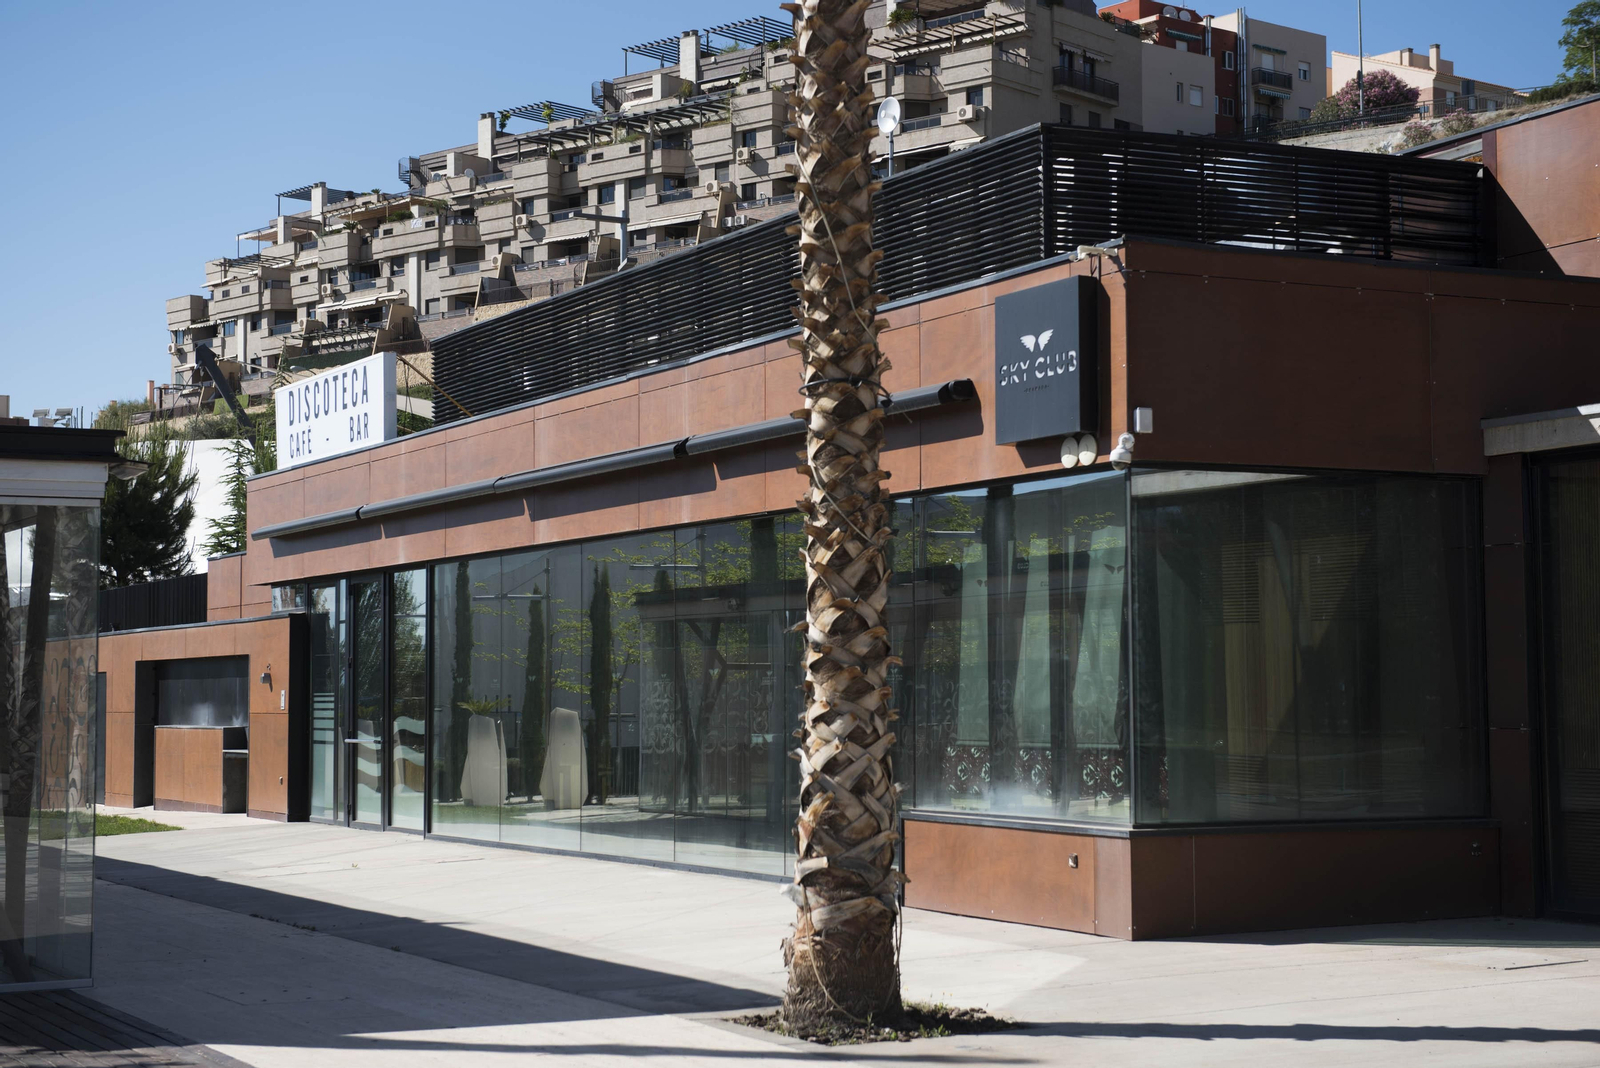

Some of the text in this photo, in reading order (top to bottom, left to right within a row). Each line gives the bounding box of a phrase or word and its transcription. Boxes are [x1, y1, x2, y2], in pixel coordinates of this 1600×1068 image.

[1000, 350, 1077, 386] SKY CLUB
[288, 365, 369, 427] DISCOTECA
[289, 425, 312, 459] CAFÉ
[349, 412, 369, 443] BAR
